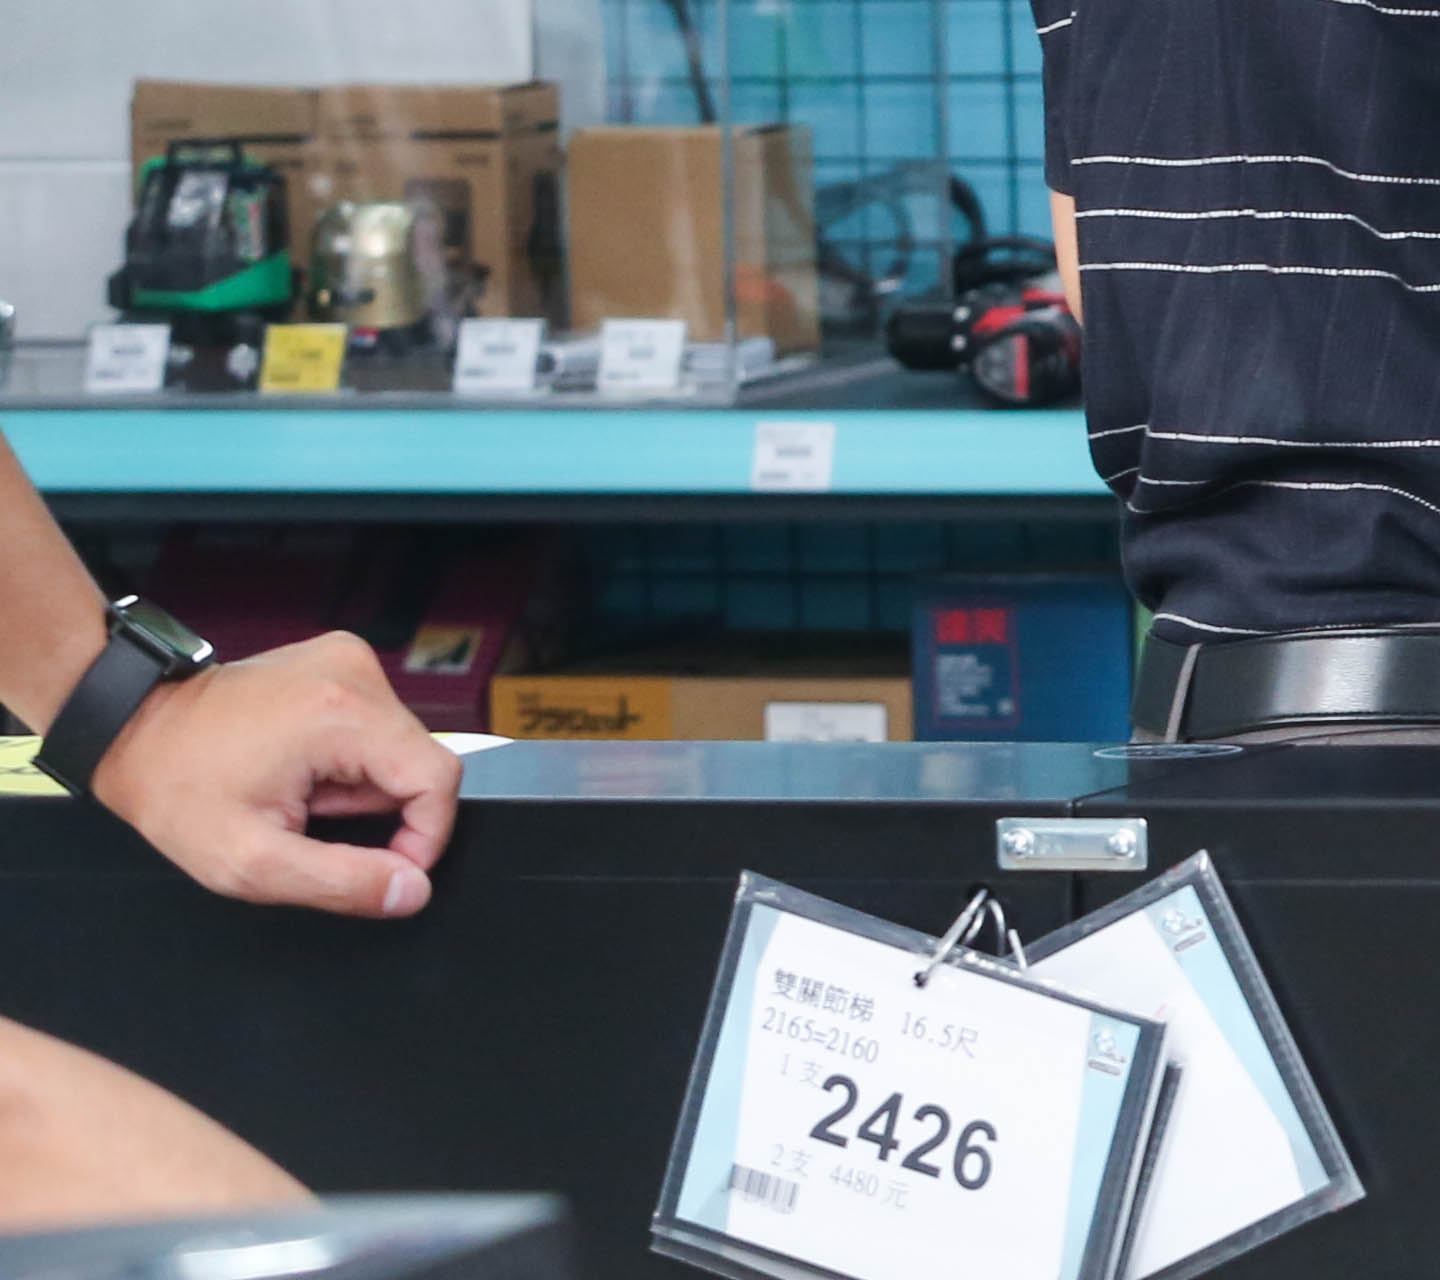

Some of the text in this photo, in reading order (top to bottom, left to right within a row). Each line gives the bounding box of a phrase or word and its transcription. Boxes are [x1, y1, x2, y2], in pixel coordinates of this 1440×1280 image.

[773, 969, 876, 1023] 雙關節梯
[760, 1006, 881, 1065] 2165=2160
[808, 1073, 999, 1192] 2426
[828, 1161, 881, 1199] 4480
